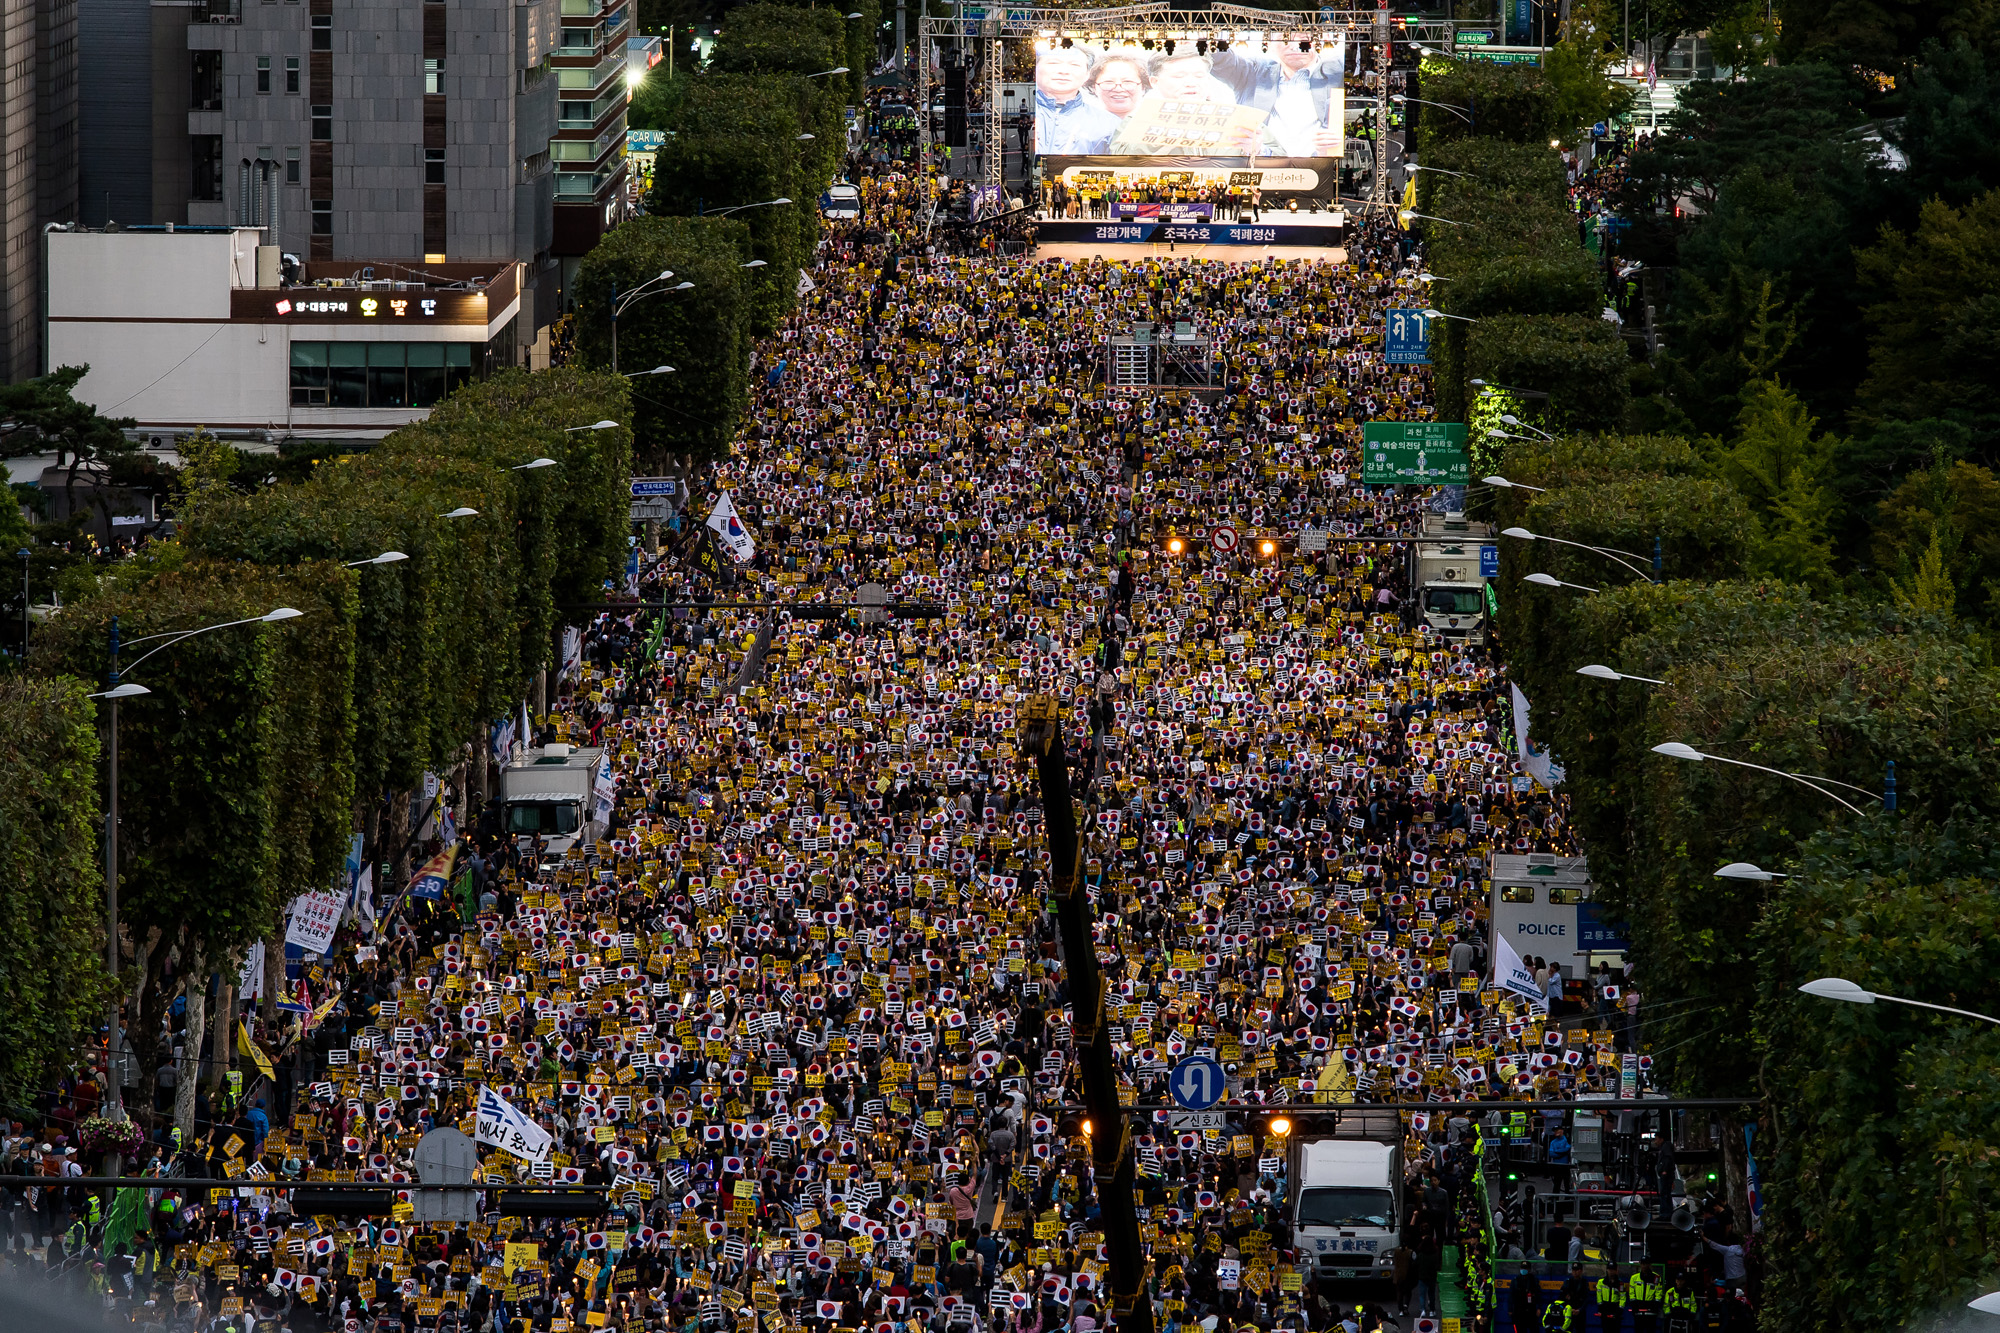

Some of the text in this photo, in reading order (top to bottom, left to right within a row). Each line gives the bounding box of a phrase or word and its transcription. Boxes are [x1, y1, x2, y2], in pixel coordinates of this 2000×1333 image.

[632, 132, 650, 142] CAR
[1096, 227, 1276, 241] 검찰개혁 조국수호 적폐청산
[1382, 442, 1420, 450] 예술의전당
[1367, 462, 1394, 471] 강남역
[1518, 924, 1566, 936] POLICE
[1190, 1114, 1223, 1126] 신호시
[480, 1121, 508, 1142] 에서
